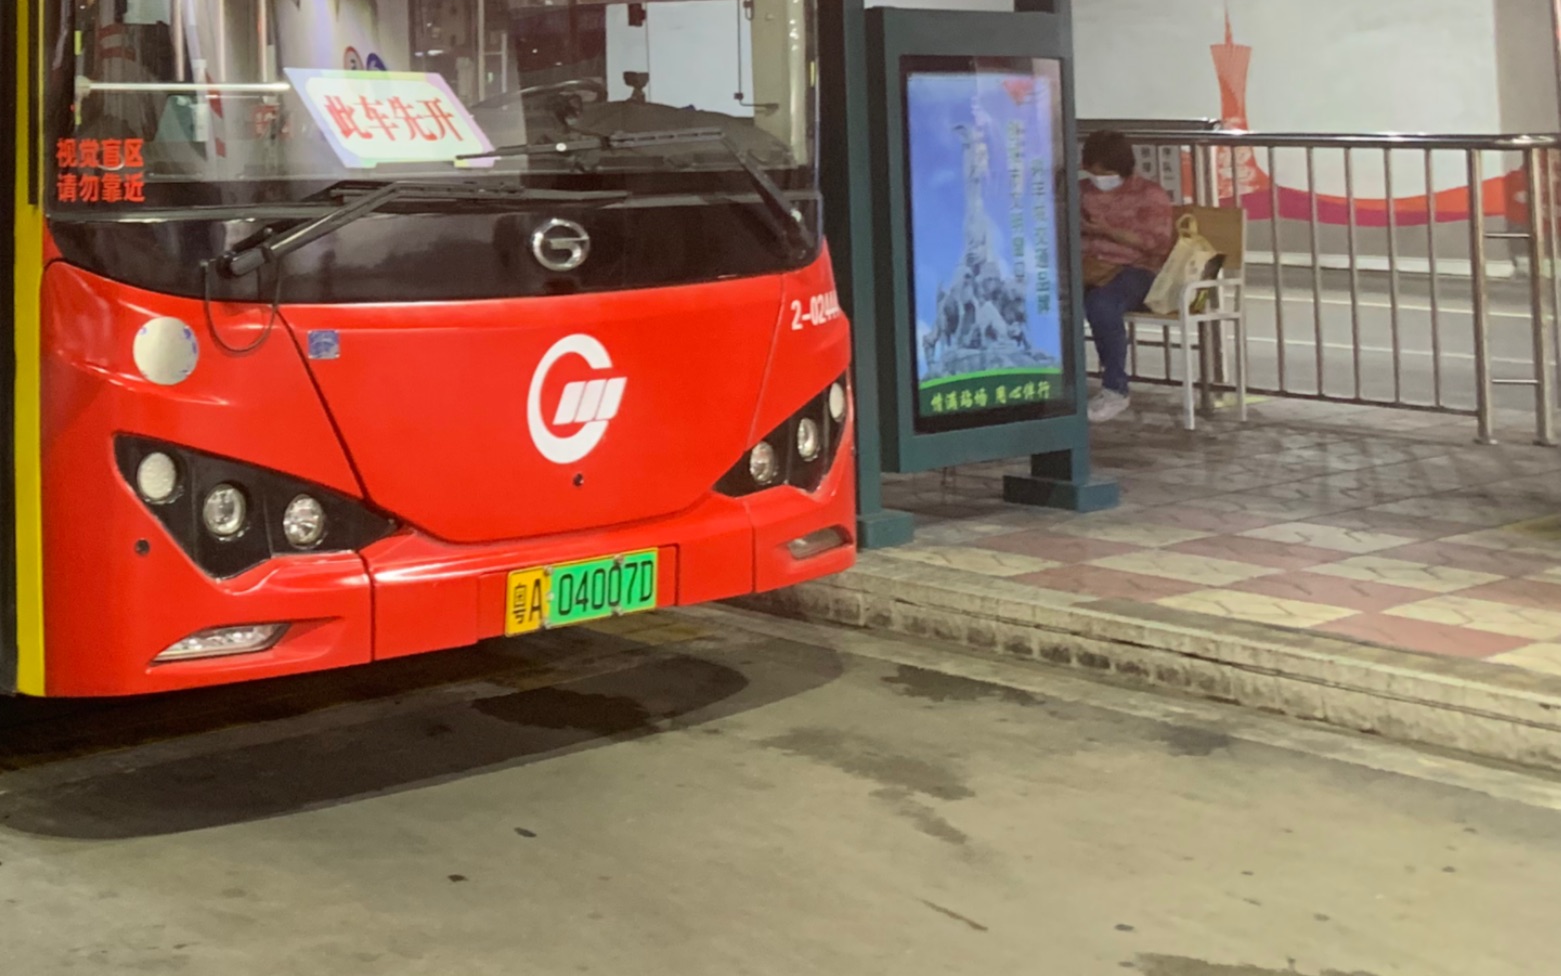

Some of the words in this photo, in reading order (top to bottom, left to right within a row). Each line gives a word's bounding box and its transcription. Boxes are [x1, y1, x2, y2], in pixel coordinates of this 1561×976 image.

[324, 94, 465, 143] 此车先开
[56, 137, 145, 168] 视觉盲区
[56, 172, 146, 203] 请勿靠近
